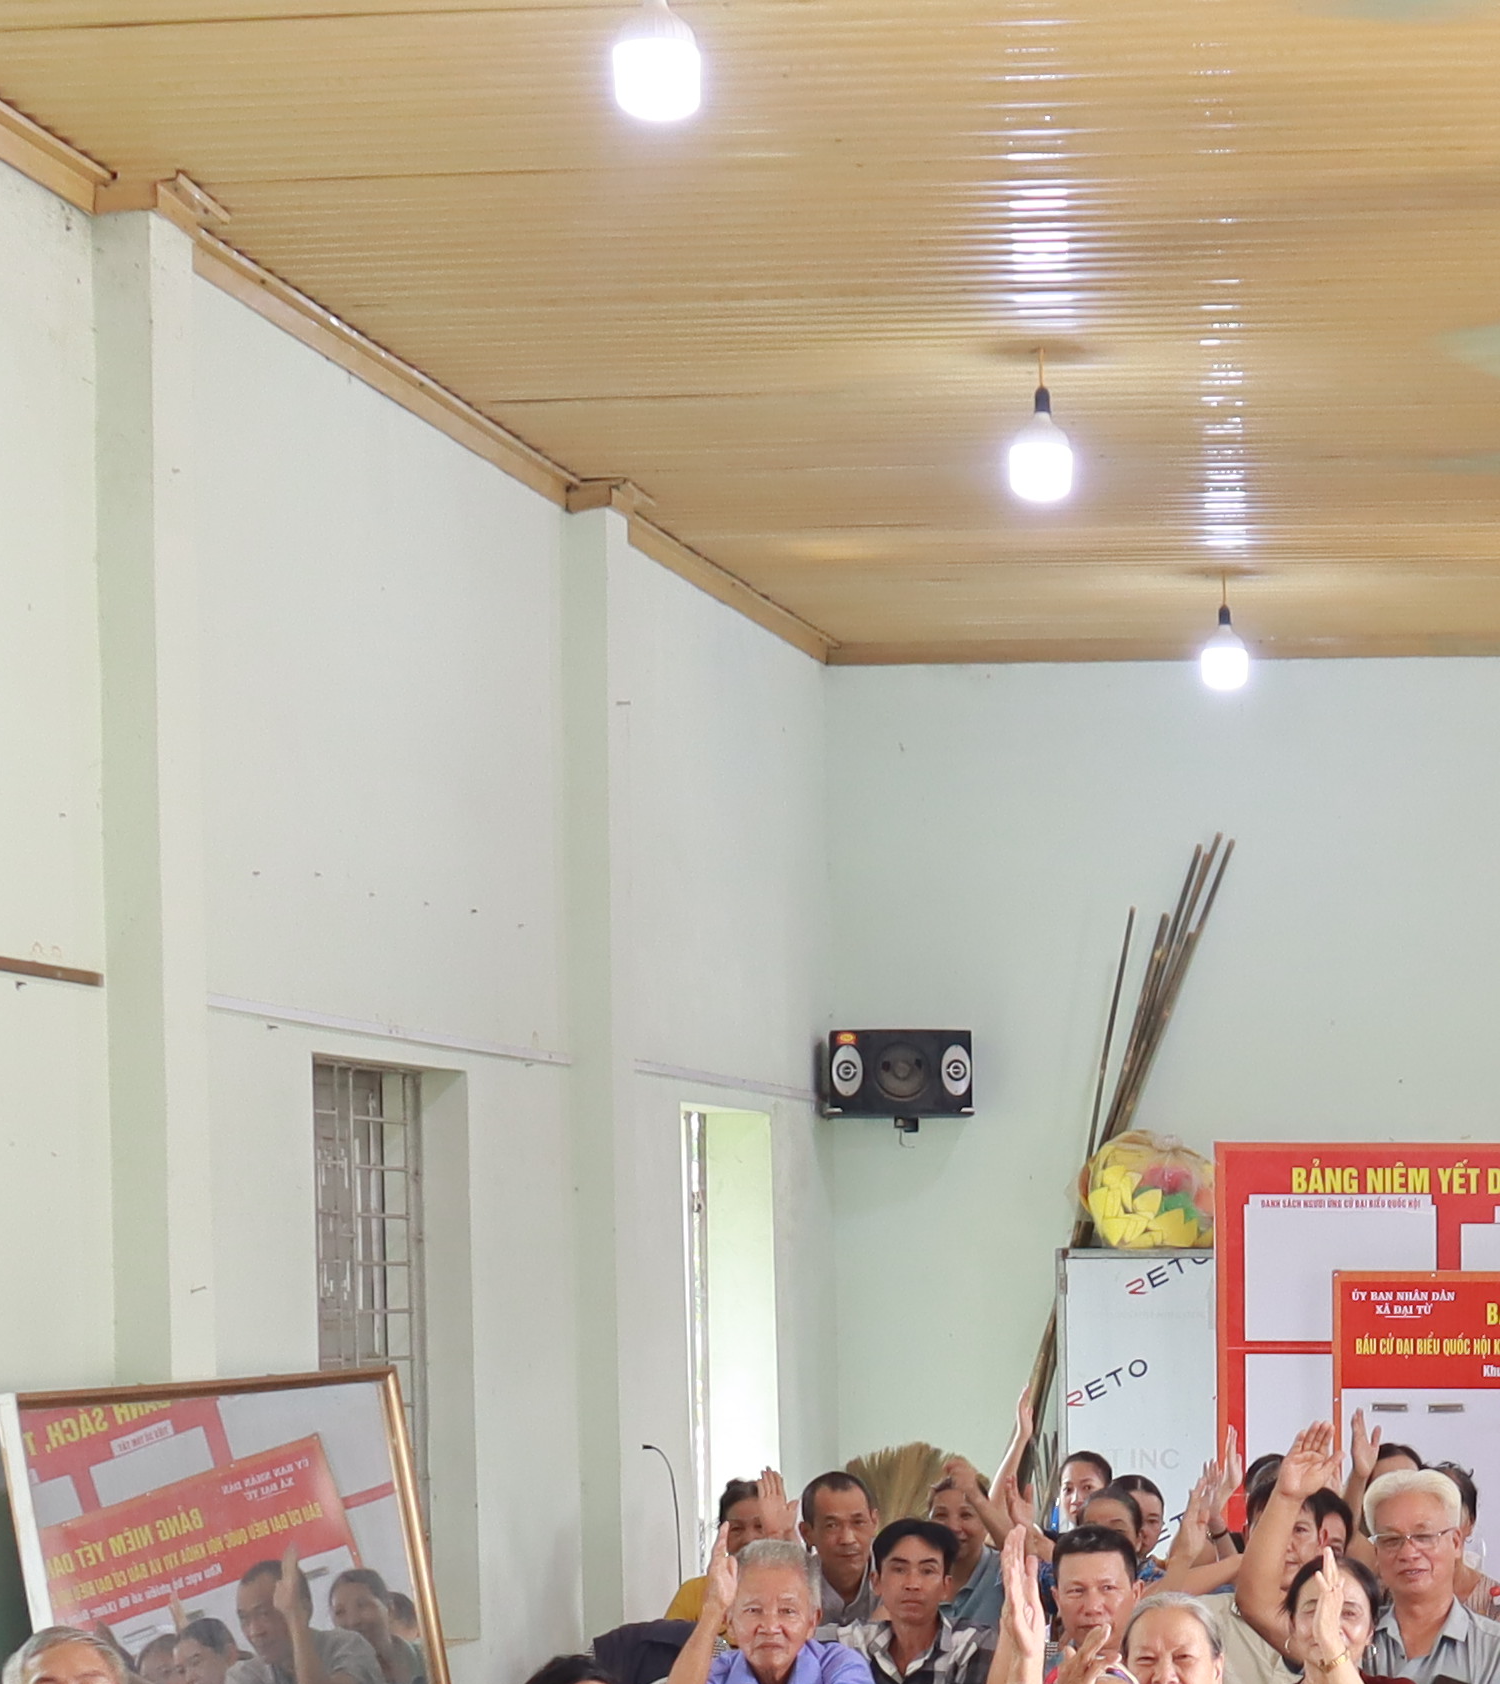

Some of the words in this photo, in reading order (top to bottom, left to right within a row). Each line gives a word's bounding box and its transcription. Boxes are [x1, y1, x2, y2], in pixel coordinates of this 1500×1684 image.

[1291, 1158, 1359, 1194] BẢNG
[1366, 1161, 1430, 1194] NIÊM
[1438, 1160, 1480, 1195] YẾT
[1370, 1291, 1394, 1301] BAN
[1396, 1288, 1429, 1301] NHÂN
[1431, 1288, 1456, 1301] DÂN
[1393, 1304, 1414, 1317] ĐẠI
[1416, 1303, 1434, 1315] TỪ
[1355, 1334, 1377, 1355] BẦU
[1379, 1333, 1395, 1355] CỬ
[1396, 1338, 1414, 1359] ĐẠI
[1417, 1332, 1441, 1355] BIỂU
[1443, 1333, 1471, 1356] QUỐC
[1473, 1335, 1491, 1359] HỘI
